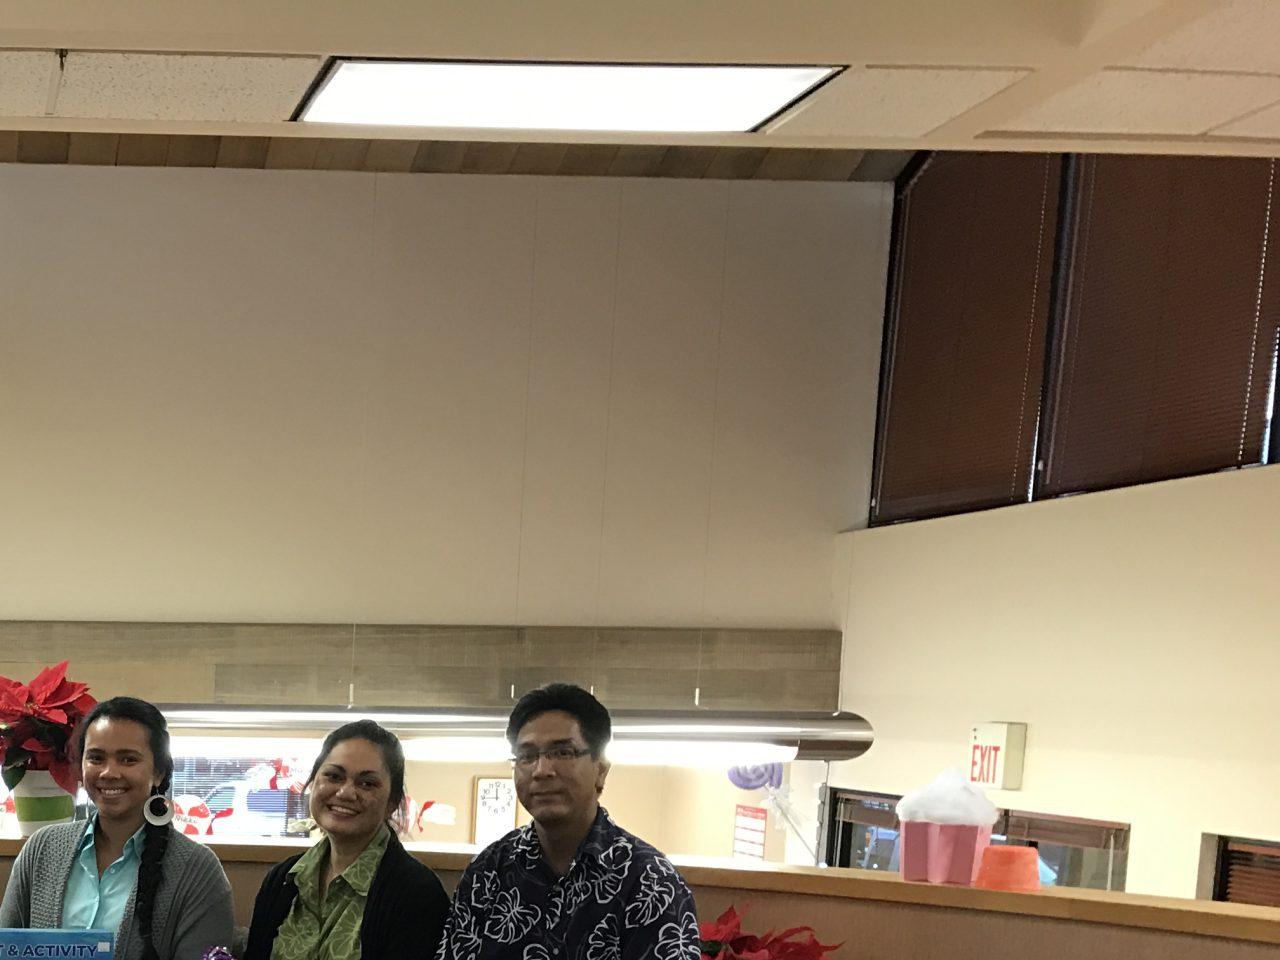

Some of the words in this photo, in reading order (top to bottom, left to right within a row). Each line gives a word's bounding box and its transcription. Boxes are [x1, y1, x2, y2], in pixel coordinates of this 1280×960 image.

[970, 744, 1001, 784] EXIT
[7, 945, 20, 957] &
[22, 945, 99, 958] ACTIVITY
